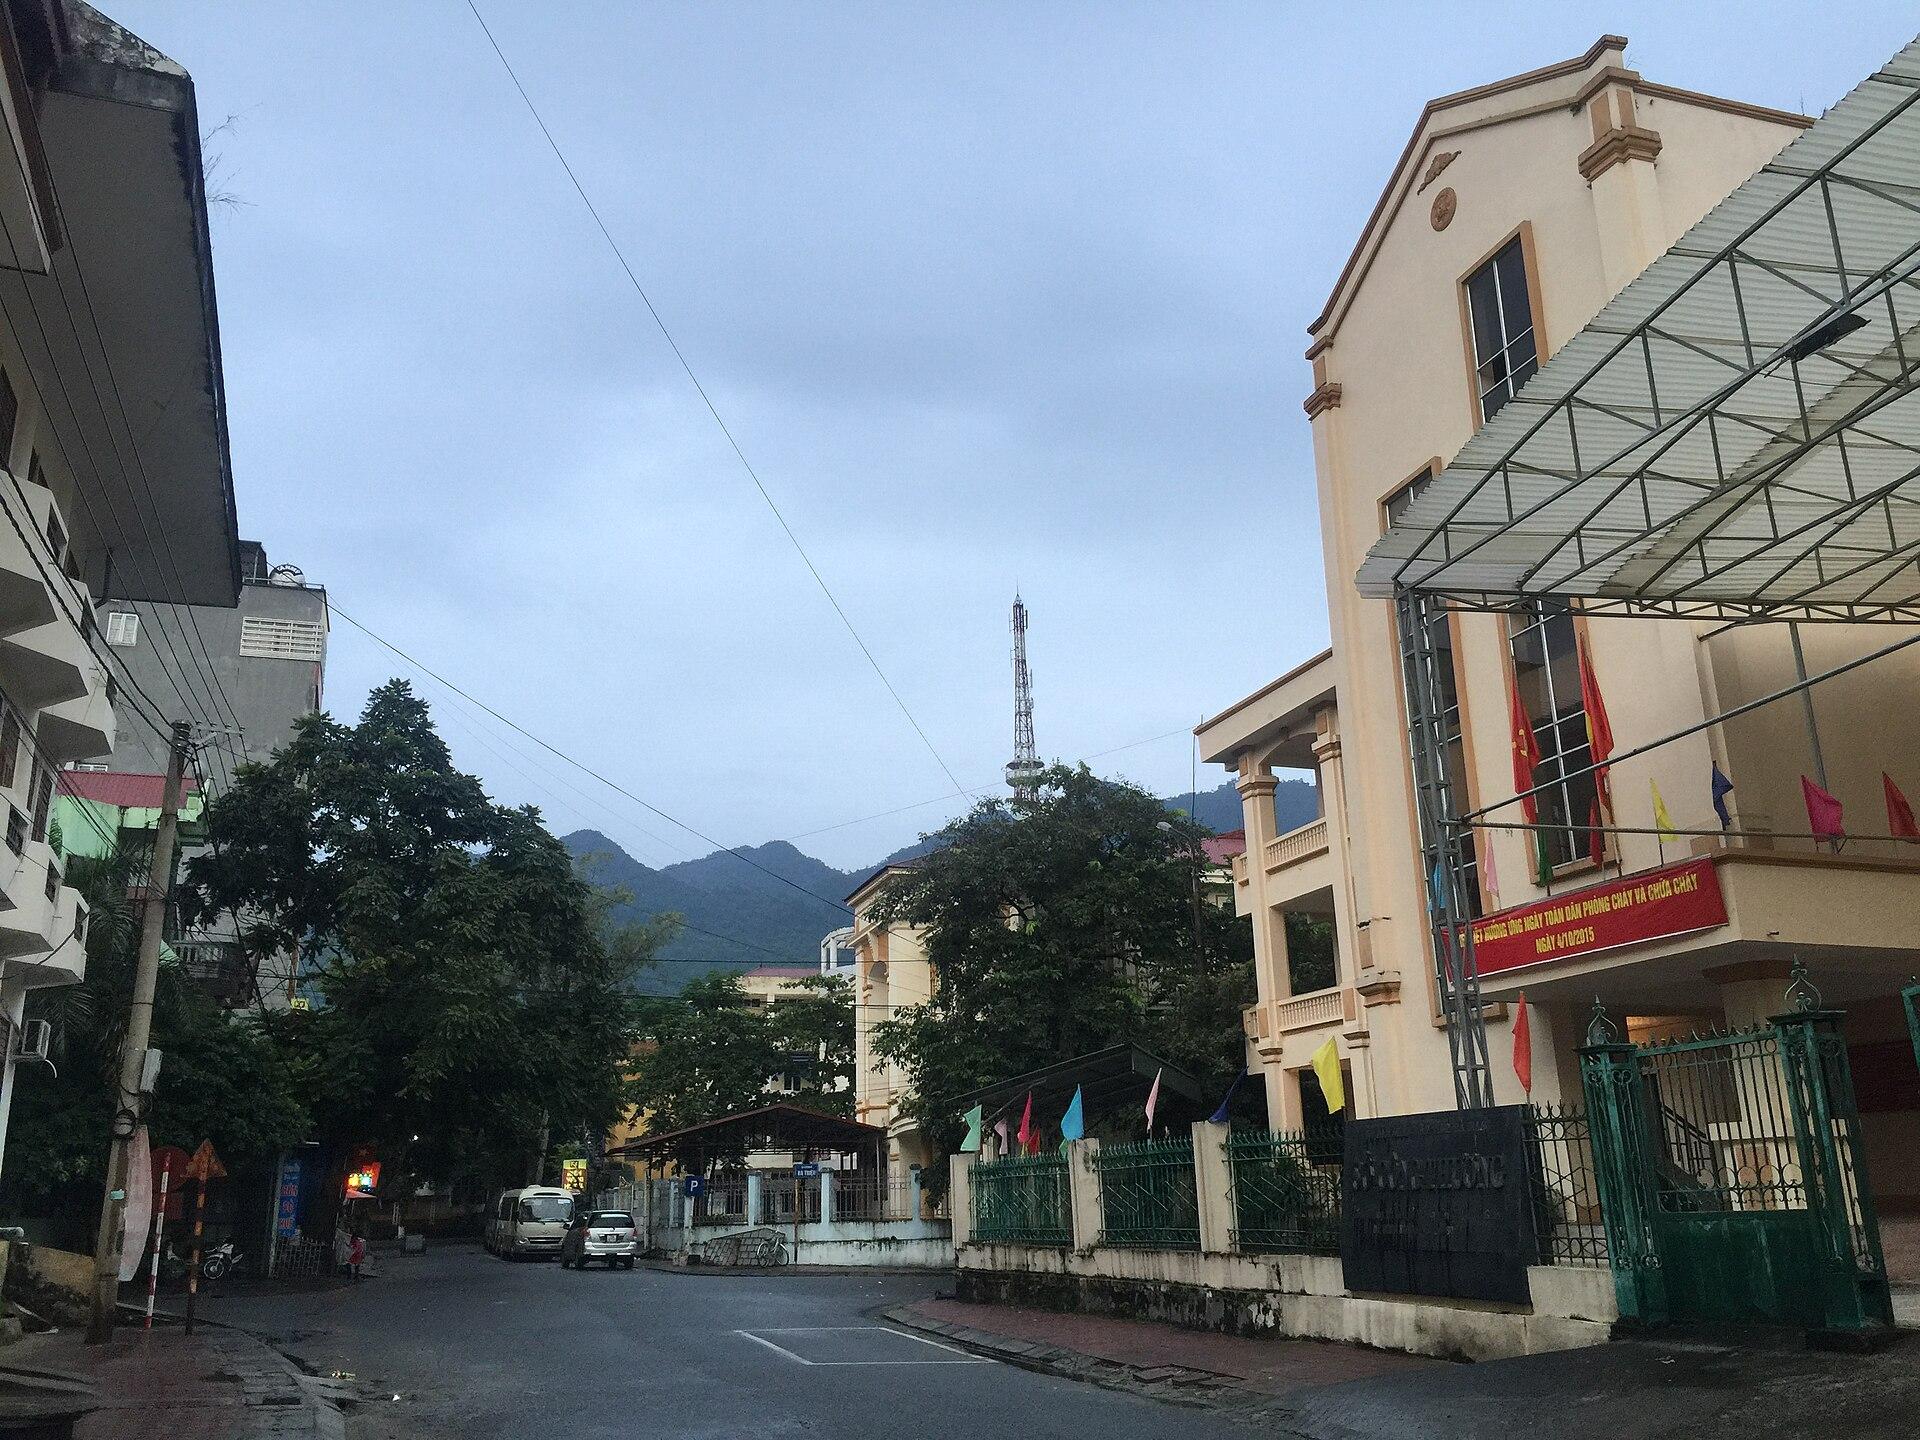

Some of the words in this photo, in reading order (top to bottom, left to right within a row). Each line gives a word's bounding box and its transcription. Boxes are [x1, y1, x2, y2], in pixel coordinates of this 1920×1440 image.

[1508, 916, 1524, 935] ỨNG
[1524, 911, 1543, 931] NGÀY
[1544, 906, 1565, 926] TOÀN
[1565, 901, 1581, 920] DÂN
[1582, 895, 1610, 917] PHÒNG
[1611, 888, 1633, 910] CHÁY
[1634, 884, 1647, 904] VÀ
[1647, 878, 1672, 901] CHỮA
[1672, 871, 1698, 894] CHÁY
[1536, 932, 1556, 953] NGÀY
[1556, 926, 1595, 949] 4/10/2015
[690, 1180, 698, 1192] P
